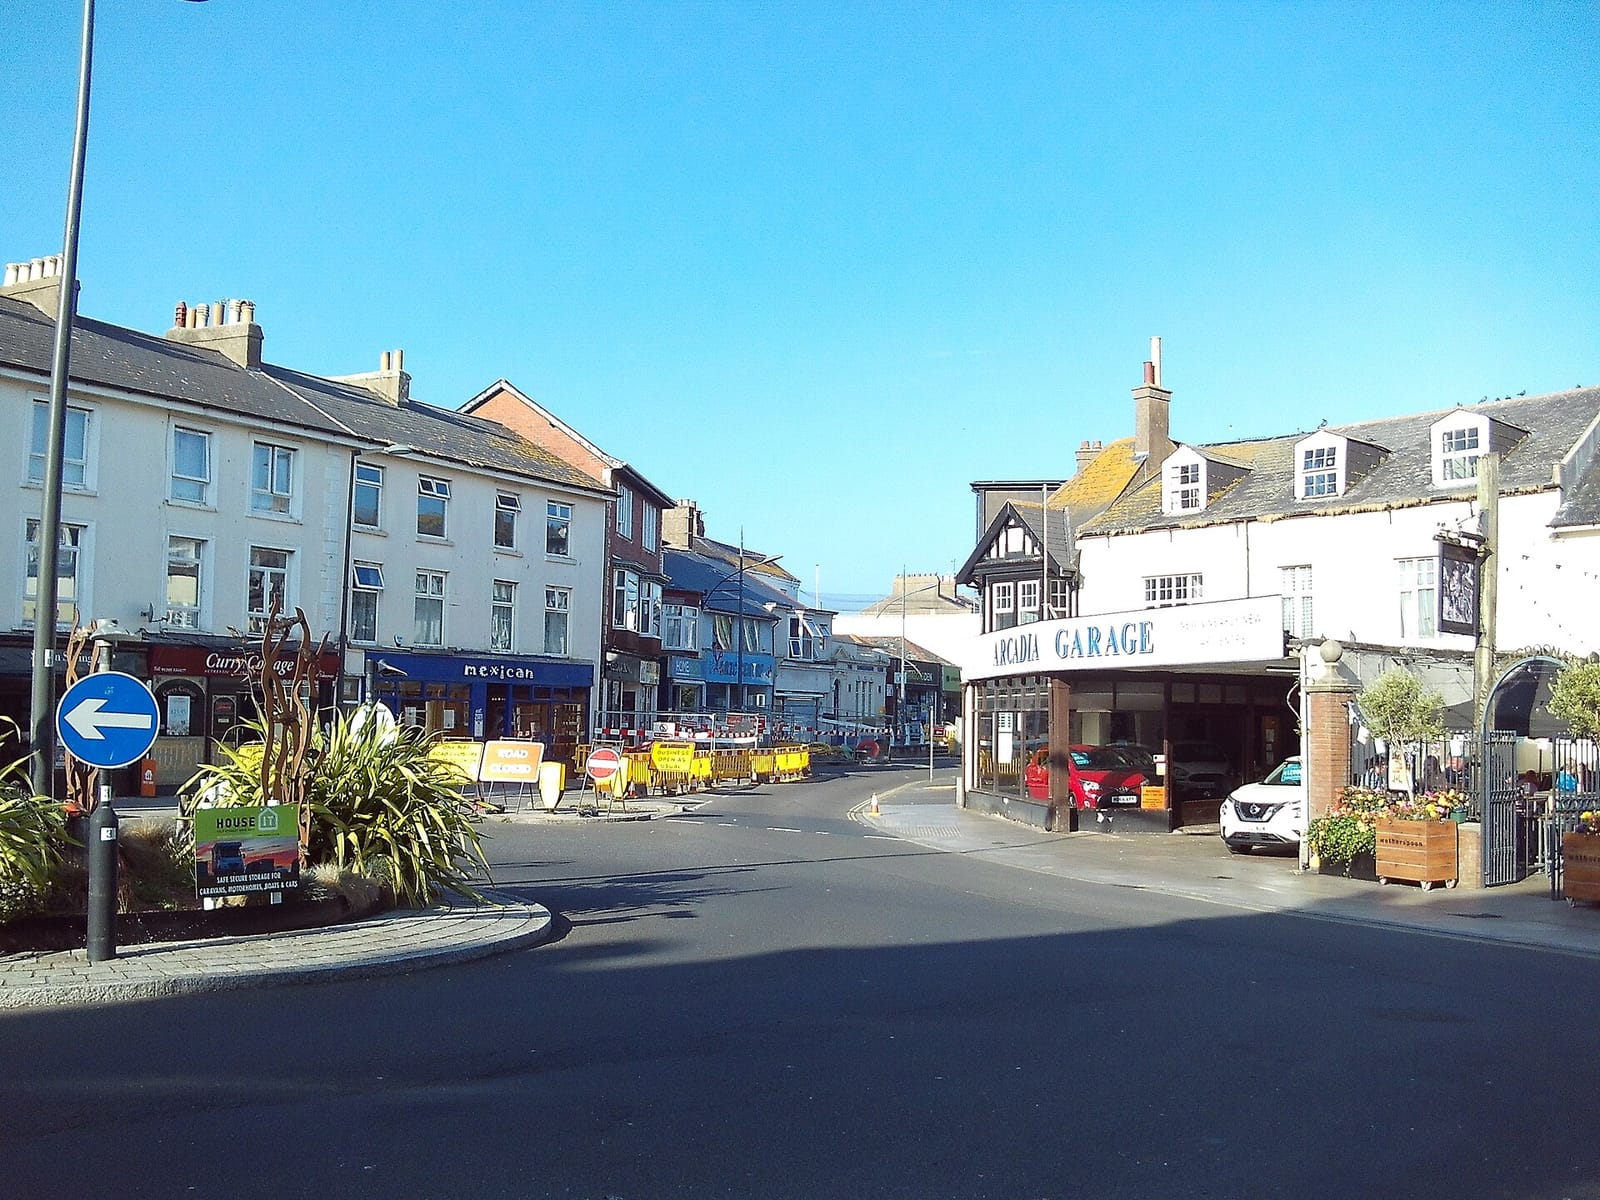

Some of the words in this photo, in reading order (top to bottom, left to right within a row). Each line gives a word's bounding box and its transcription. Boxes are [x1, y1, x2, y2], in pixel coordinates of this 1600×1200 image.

[993, 633, 1040, 667] ARCADIA
[1055, 620, 1155, 660] GARAGE
[206, 653, 245, 673] Curry
[248, 653, 295, 675] Coage
[464, 664, 534, 680] mexican
[216, 817, 256, 829] HOUSE
[262, 815, 275, 827] IT
[1380, 838, 1423, 847] wetherspoon
[216, 875, 229, 884] SAFE
[229, 874, 248, 882] SECURE
[248, 873, 271, 881] STORAGE
[271, 871, 281, 880] FOR
[200, 886, 227, 895] CARAVANS,
[228, 884, 263, 893] MOTORHOMES,
[263, 882, 280, 890] BOATS
[285, 880, 298, 888] CARS
